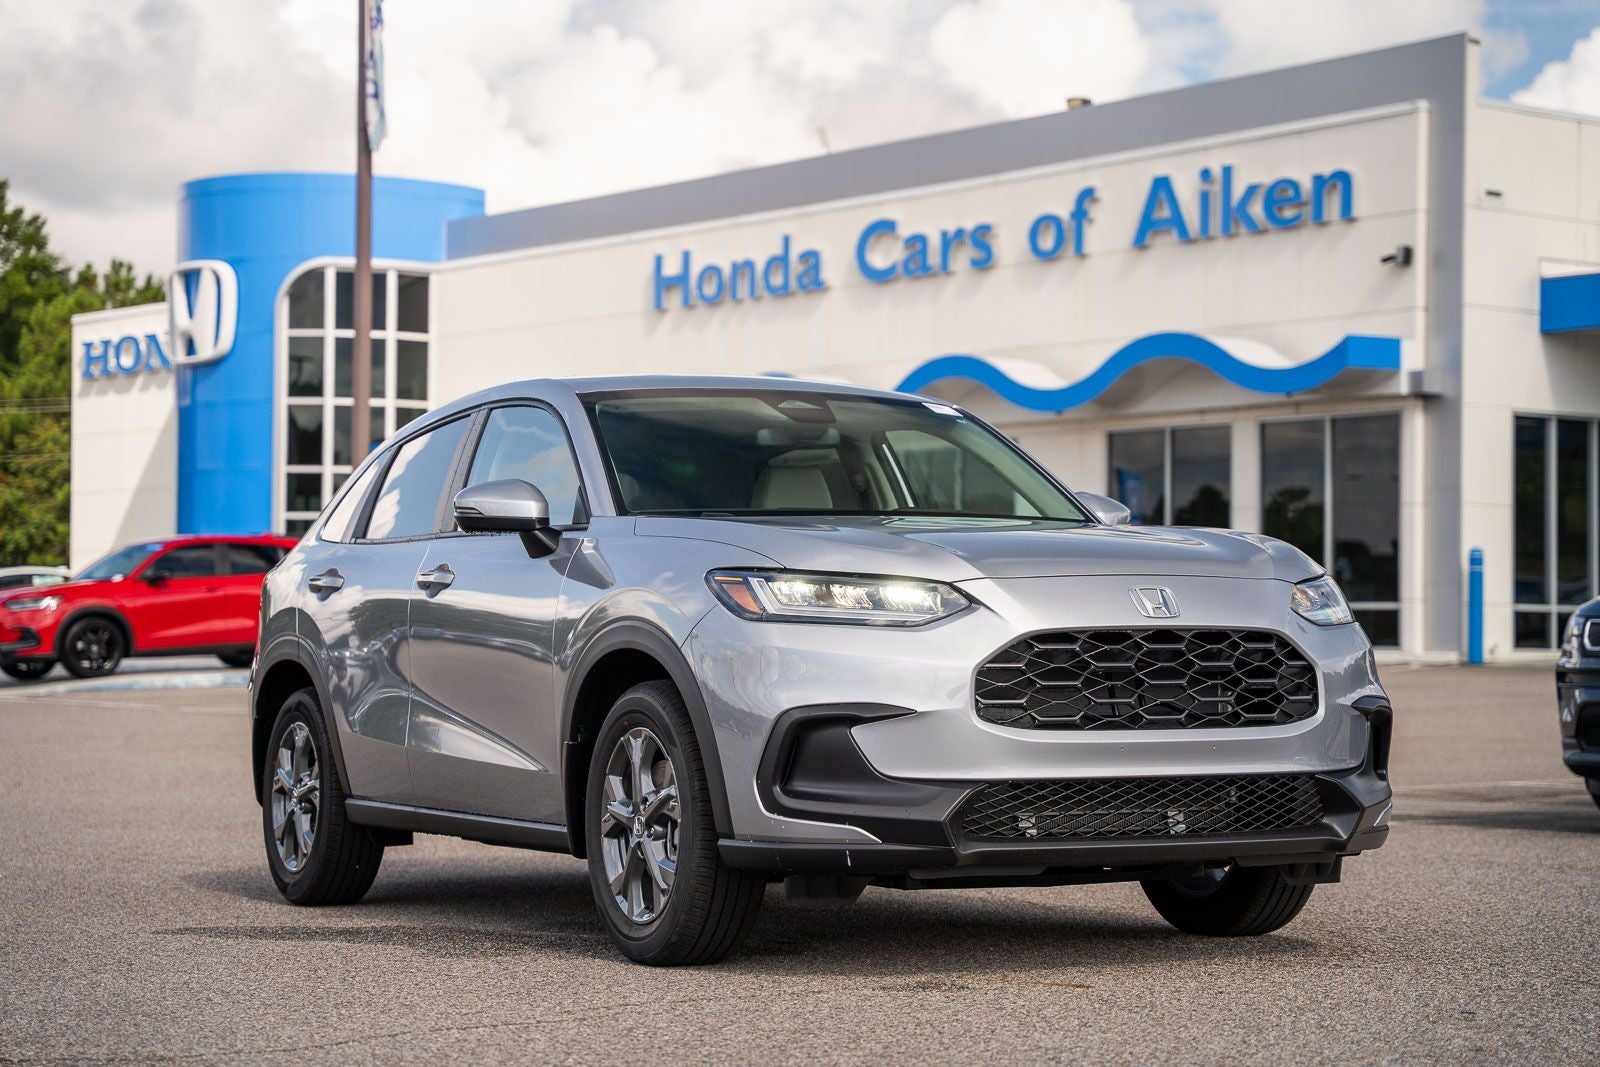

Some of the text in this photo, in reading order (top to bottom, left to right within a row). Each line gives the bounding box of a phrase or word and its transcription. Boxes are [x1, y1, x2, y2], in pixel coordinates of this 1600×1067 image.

[654, 165, 1353, 310] Honda Cars of Aiken
